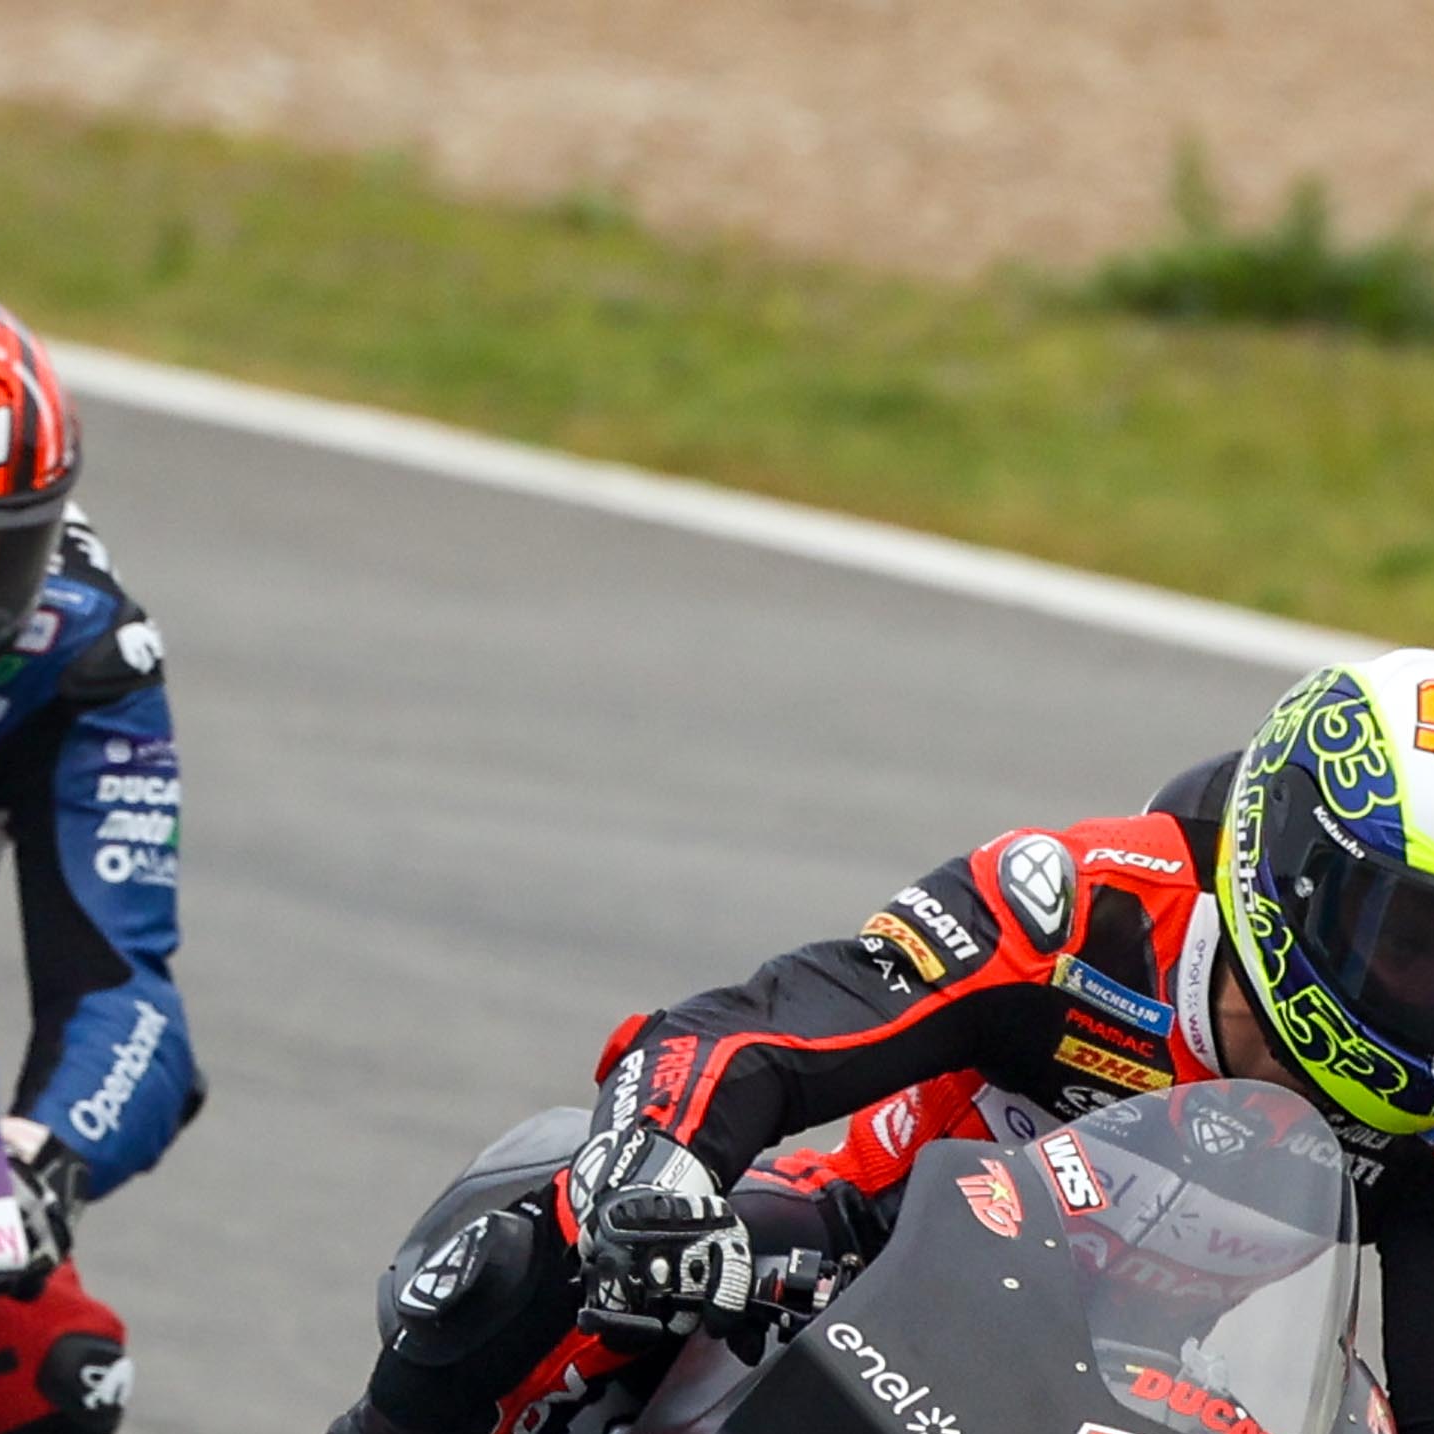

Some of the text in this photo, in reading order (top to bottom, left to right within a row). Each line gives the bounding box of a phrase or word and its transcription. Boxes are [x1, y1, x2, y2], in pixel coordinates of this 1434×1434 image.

[1084, 977, 1162, 1024] MICHELIN
[1042, 1132, 1104, 1209] WRS
[825, 1322, 931, 1416] enel
